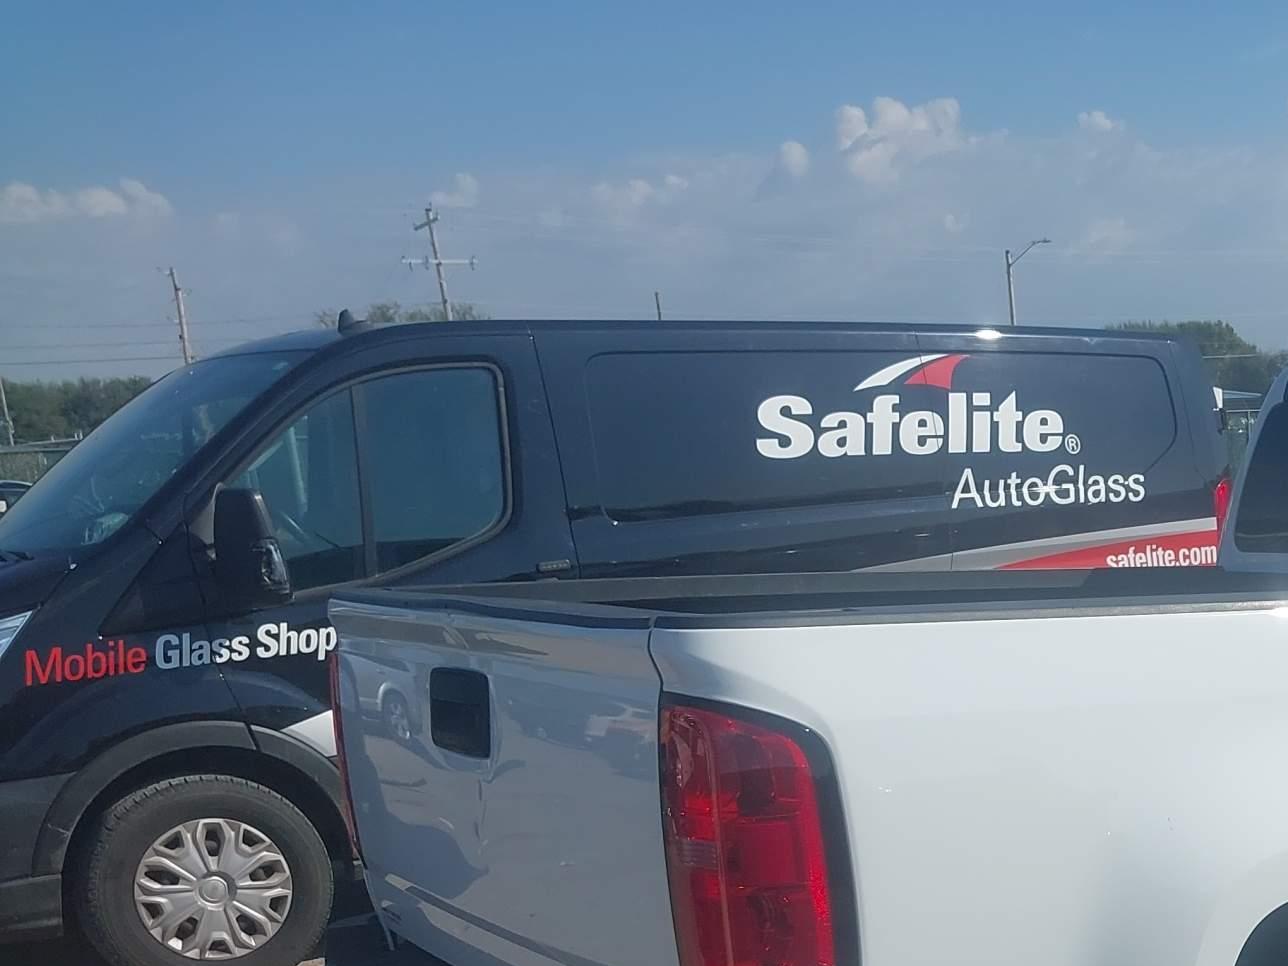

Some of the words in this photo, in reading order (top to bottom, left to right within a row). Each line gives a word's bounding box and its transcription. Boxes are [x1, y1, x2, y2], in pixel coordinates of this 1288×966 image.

[951, 464, 1146, 509] AutoGlass
[1106, 544, 1218, 568] safelite.com
[25, 639, 147, 687] Mobile
[155, 632, 250, 670] Glass
[256, 621, 338, 661] Shop
